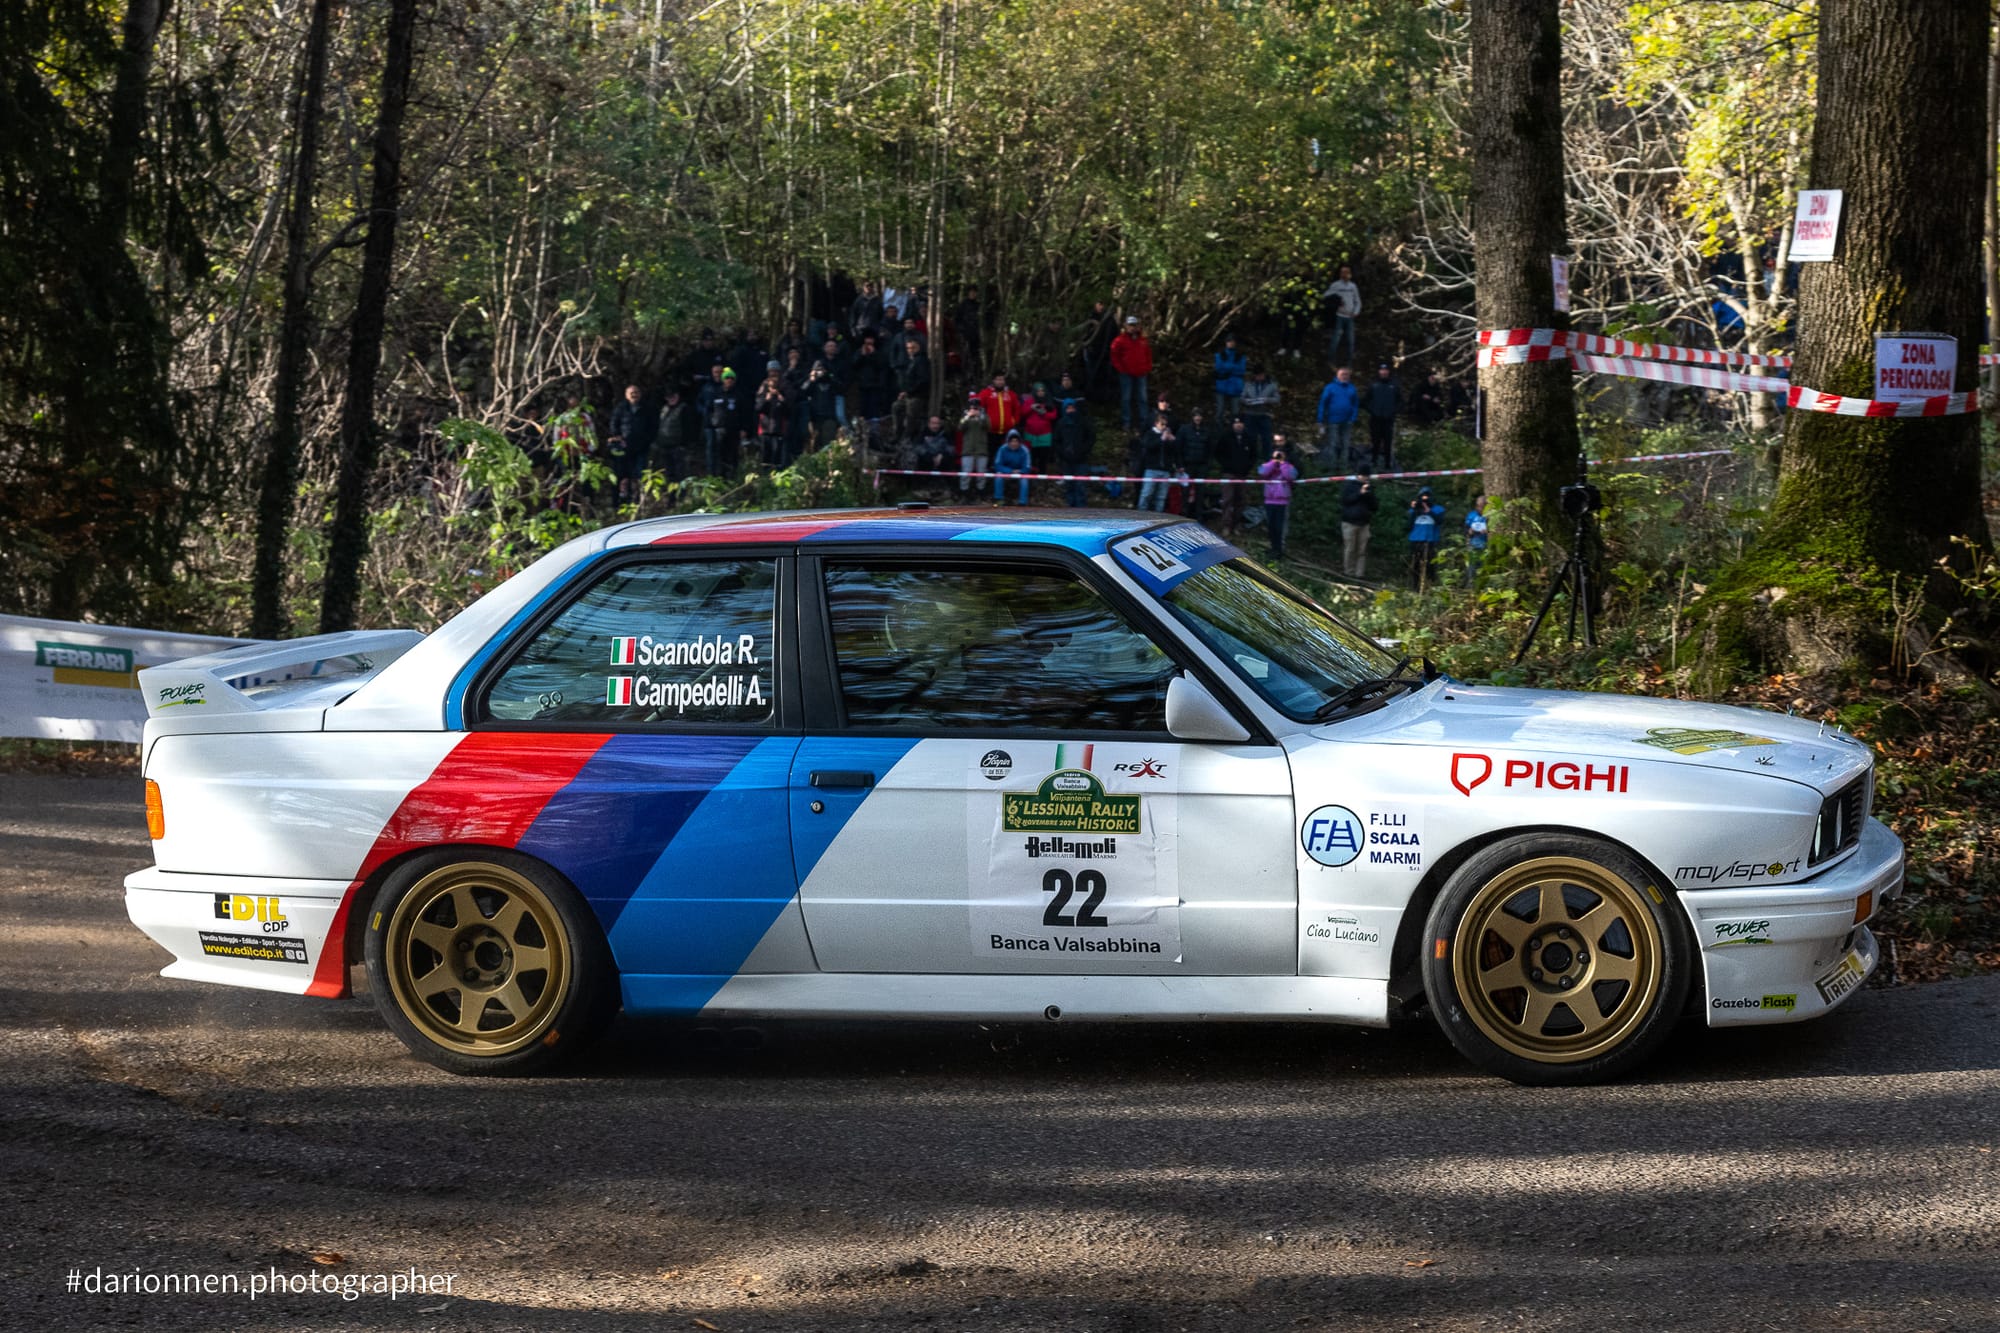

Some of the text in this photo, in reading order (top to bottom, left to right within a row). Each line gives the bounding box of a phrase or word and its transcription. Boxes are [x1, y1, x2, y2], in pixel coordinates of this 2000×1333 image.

[1901, 344, 1936, 365] ZONA
[1880, 368, 1951, 390] PERICOLOSA
[1131, 543, 1177, 571] 22
[638, 634, 759, 665] Scandola R.
[44, 647, 126, 671] FERRARI
[159, 683, 206, 701] POWER
[634, 675, 767, 713] Campedelli A.
[1505, 760, 1630, 793] PIGHI
[1023, 801, 1085, 815] LESSINIA
[1091, 802, 1136, 817] RALLY
[1077, 817, 1136, 830] HISTORIC
[1370, 813, 1406, 826] F.LLI
[1370, 832, 1420, 845] SCALA
[1025, 837, 1116, 859] Bellamoli
[1370, 851, 1421, 865] MARMI
[1675, 857, 1801, 882] movisport
[1042, 868, 1109, 927] 22
[263, 921, 289, 933] CDP
[1306, 924, 1379, 942] Ciao Luciano
[1715, 920, 1770, 938] POWER
[204, 944, 284, 959] www.edilcdp.it
[991, 934, 1161, 953] Banca Valsabbina
[1712, 996, 1796, 1009] Gazebo Flash
